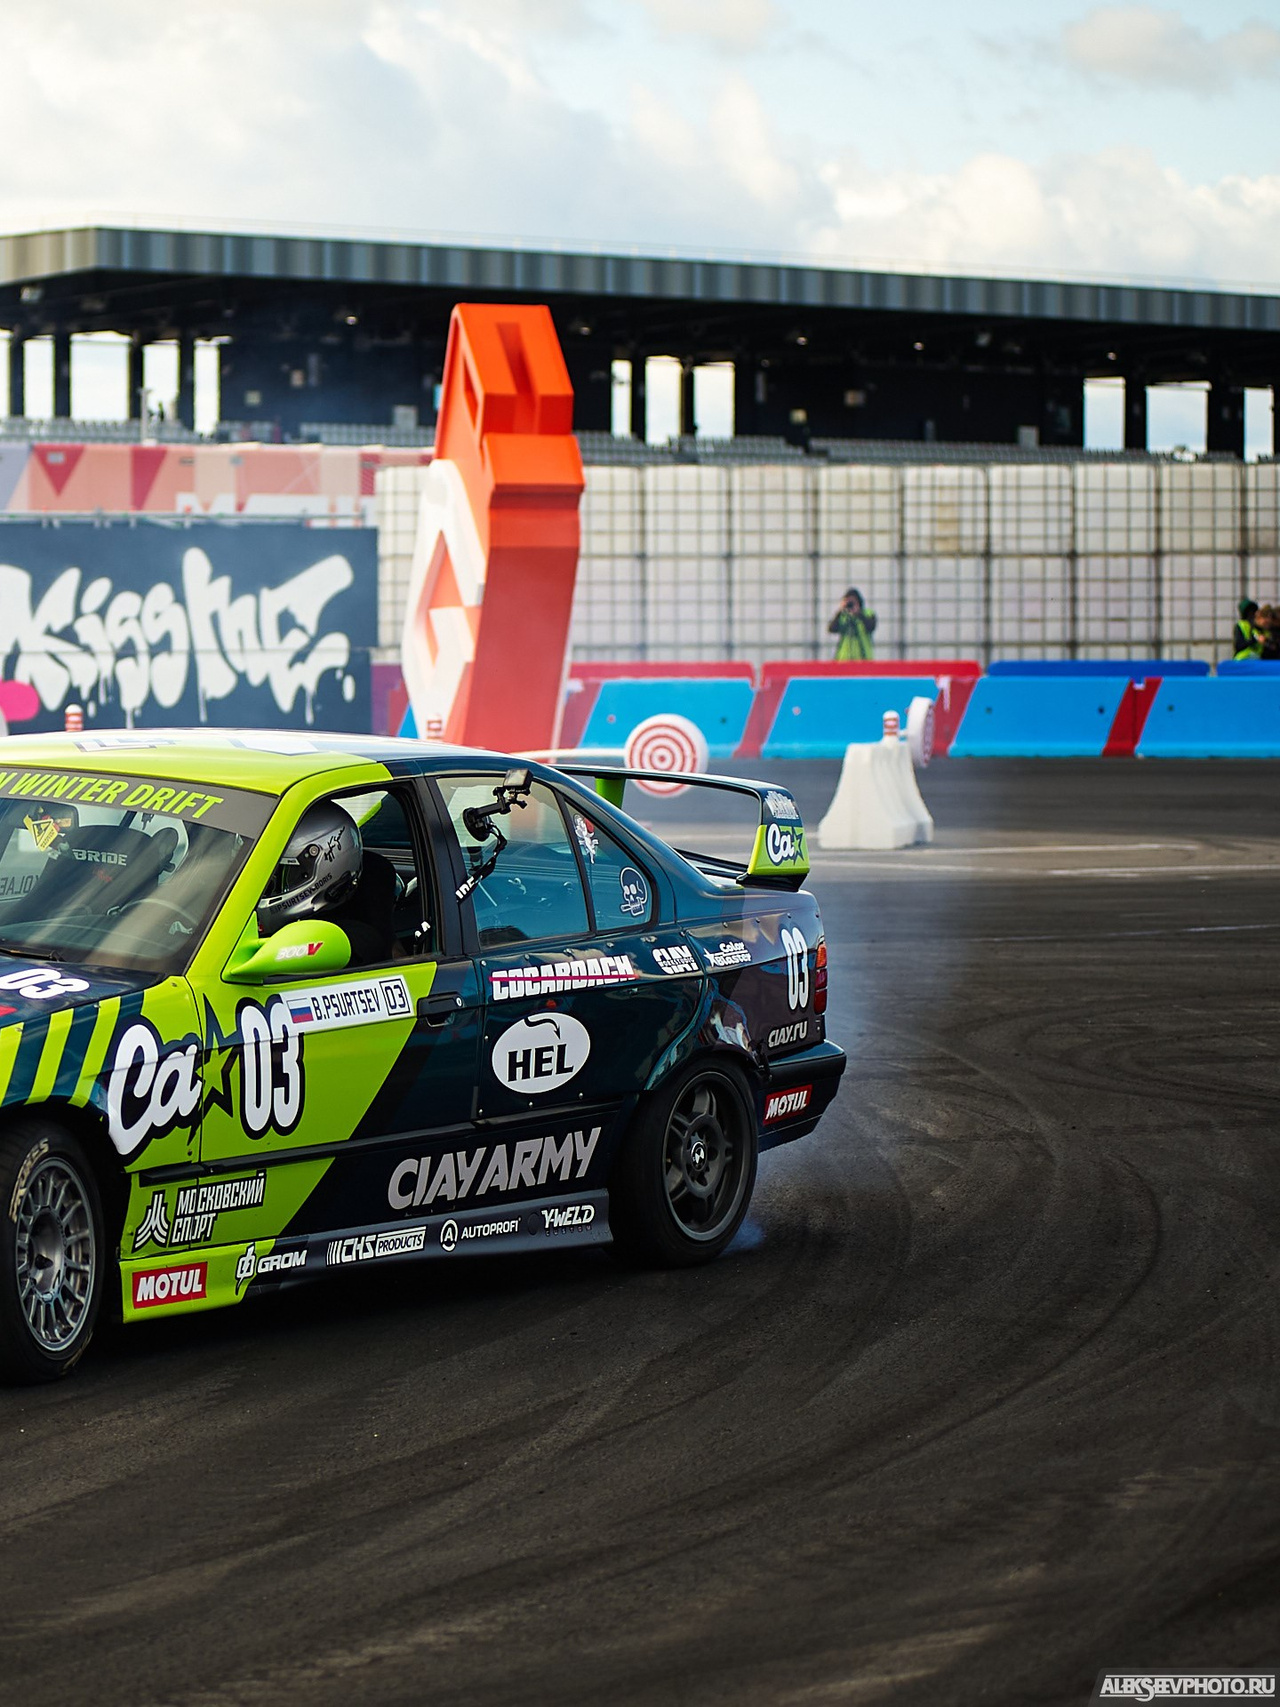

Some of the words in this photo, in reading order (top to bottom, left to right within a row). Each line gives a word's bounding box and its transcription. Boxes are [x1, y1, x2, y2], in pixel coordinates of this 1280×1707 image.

[9, 772, 128, 804] WINTER
[123, 784, 224, 819] DRIFT
[72, 848, 128, 866] BRIDE
[275, 941, 323, 961] 300V
[781, 927, 809, 1010] 03
[311, 987, 381, 1021] B.PSURTSEV
[384, 984, 406, 1010] 03
[239, 1000, 301, 1132] 03
[507, 1043, 574, 1083] HEL
[765, 1090, 808, 1120] MOTUL
[176, 1172, 265, 1216] МОСКОВСКИЙ
[171, 1212, 217, 1244] СПОРТ
[378, 1230, 425, 1254] PRODUCTS
[461, 1219, 519, 1240] AUTOPROFI
[257, 1249, 308, 1273] GROM
[136, 1268, 203, 1302] MOTUL
